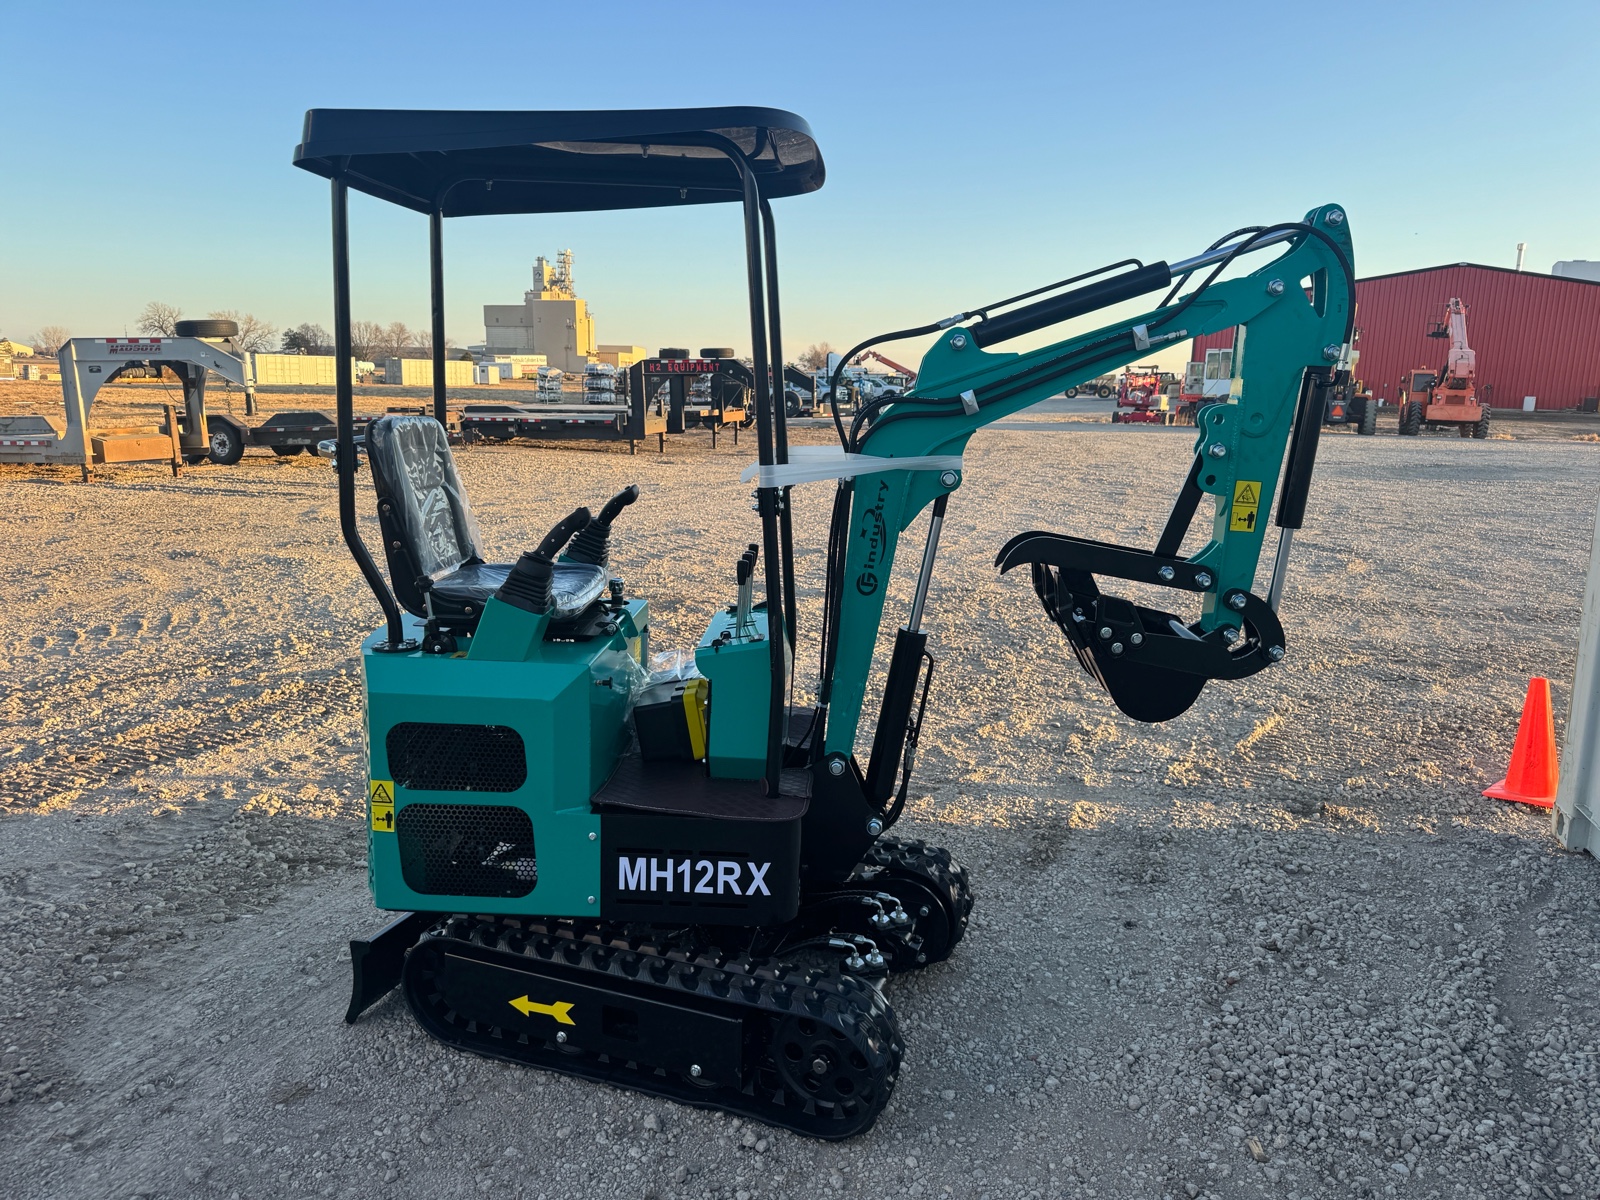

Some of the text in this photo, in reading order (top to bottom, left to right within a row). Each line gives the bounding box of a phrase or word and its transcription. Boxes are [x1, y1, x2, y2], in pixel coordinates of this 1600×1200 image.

[649, 363, 720, 373] H2 EQUIPMENT
[618, 856, 772, 896] MH12RX
